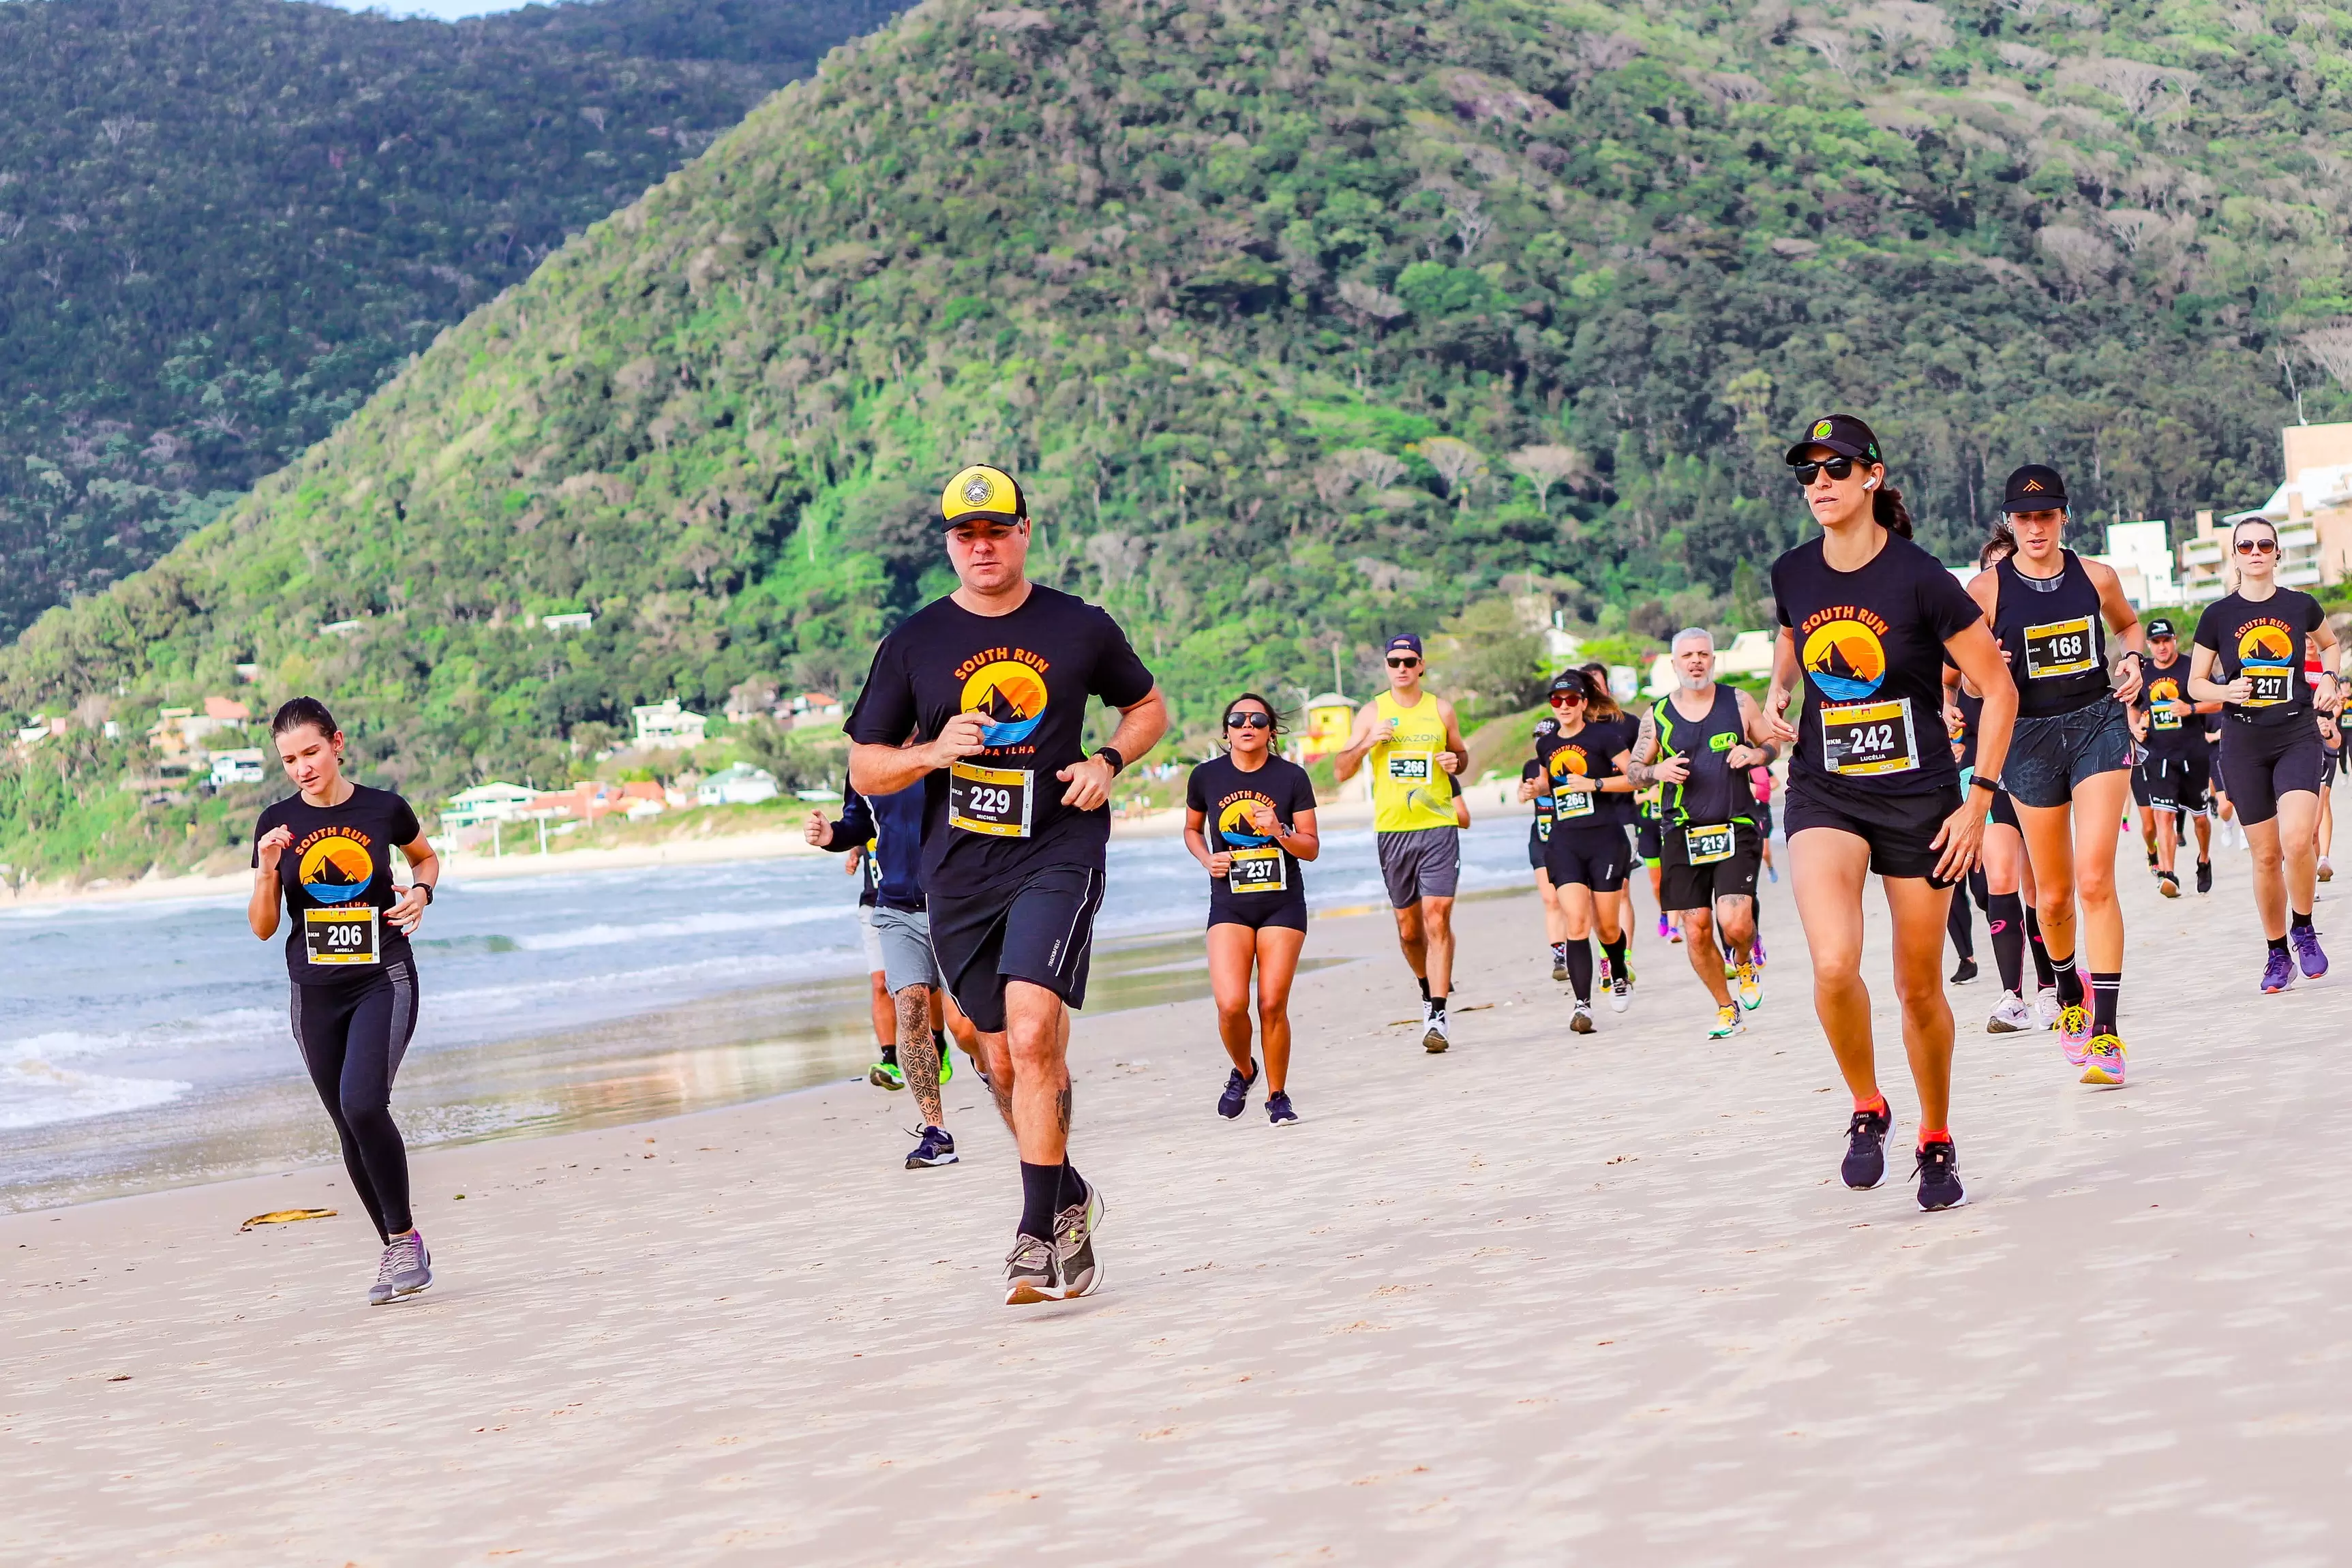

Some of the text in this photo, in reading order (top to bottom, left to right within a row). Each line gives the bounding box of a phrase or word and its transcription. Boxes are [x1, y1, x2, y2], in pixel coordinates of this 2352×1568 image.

[1802, 606, 1889, 636] SOUTH RUN
[2234, 618, 2291, 639] SOUTH RUN
[2049, 635, 2082, 657] 168
[954, 647, 1049, 680] SOUTH RUN
[2148, 677, 2178, 690] SOUTH RUN
[2257, 678, 2282, 694] 217
[1714, 738, 1724, 747] ON
[1850, 724, 1895, 754] 242
[1006, 746, 1035, 755] ILHA
[1549, 744, 1587, 761] SOUTH RUN
[1403, 760, 1425, 774] 266
[969, 786, 1010, 814] 229
[1218, 790, 1277, 809] SOUTH RUN
[1565, 792, 1585, 807] 266
[295, 826, 371, 856] SOUTH RUN
[1701, 835, 1724, 851] 213
[1246, 860, 1273, 878] 237
[327, 924, 363, 946] 206
